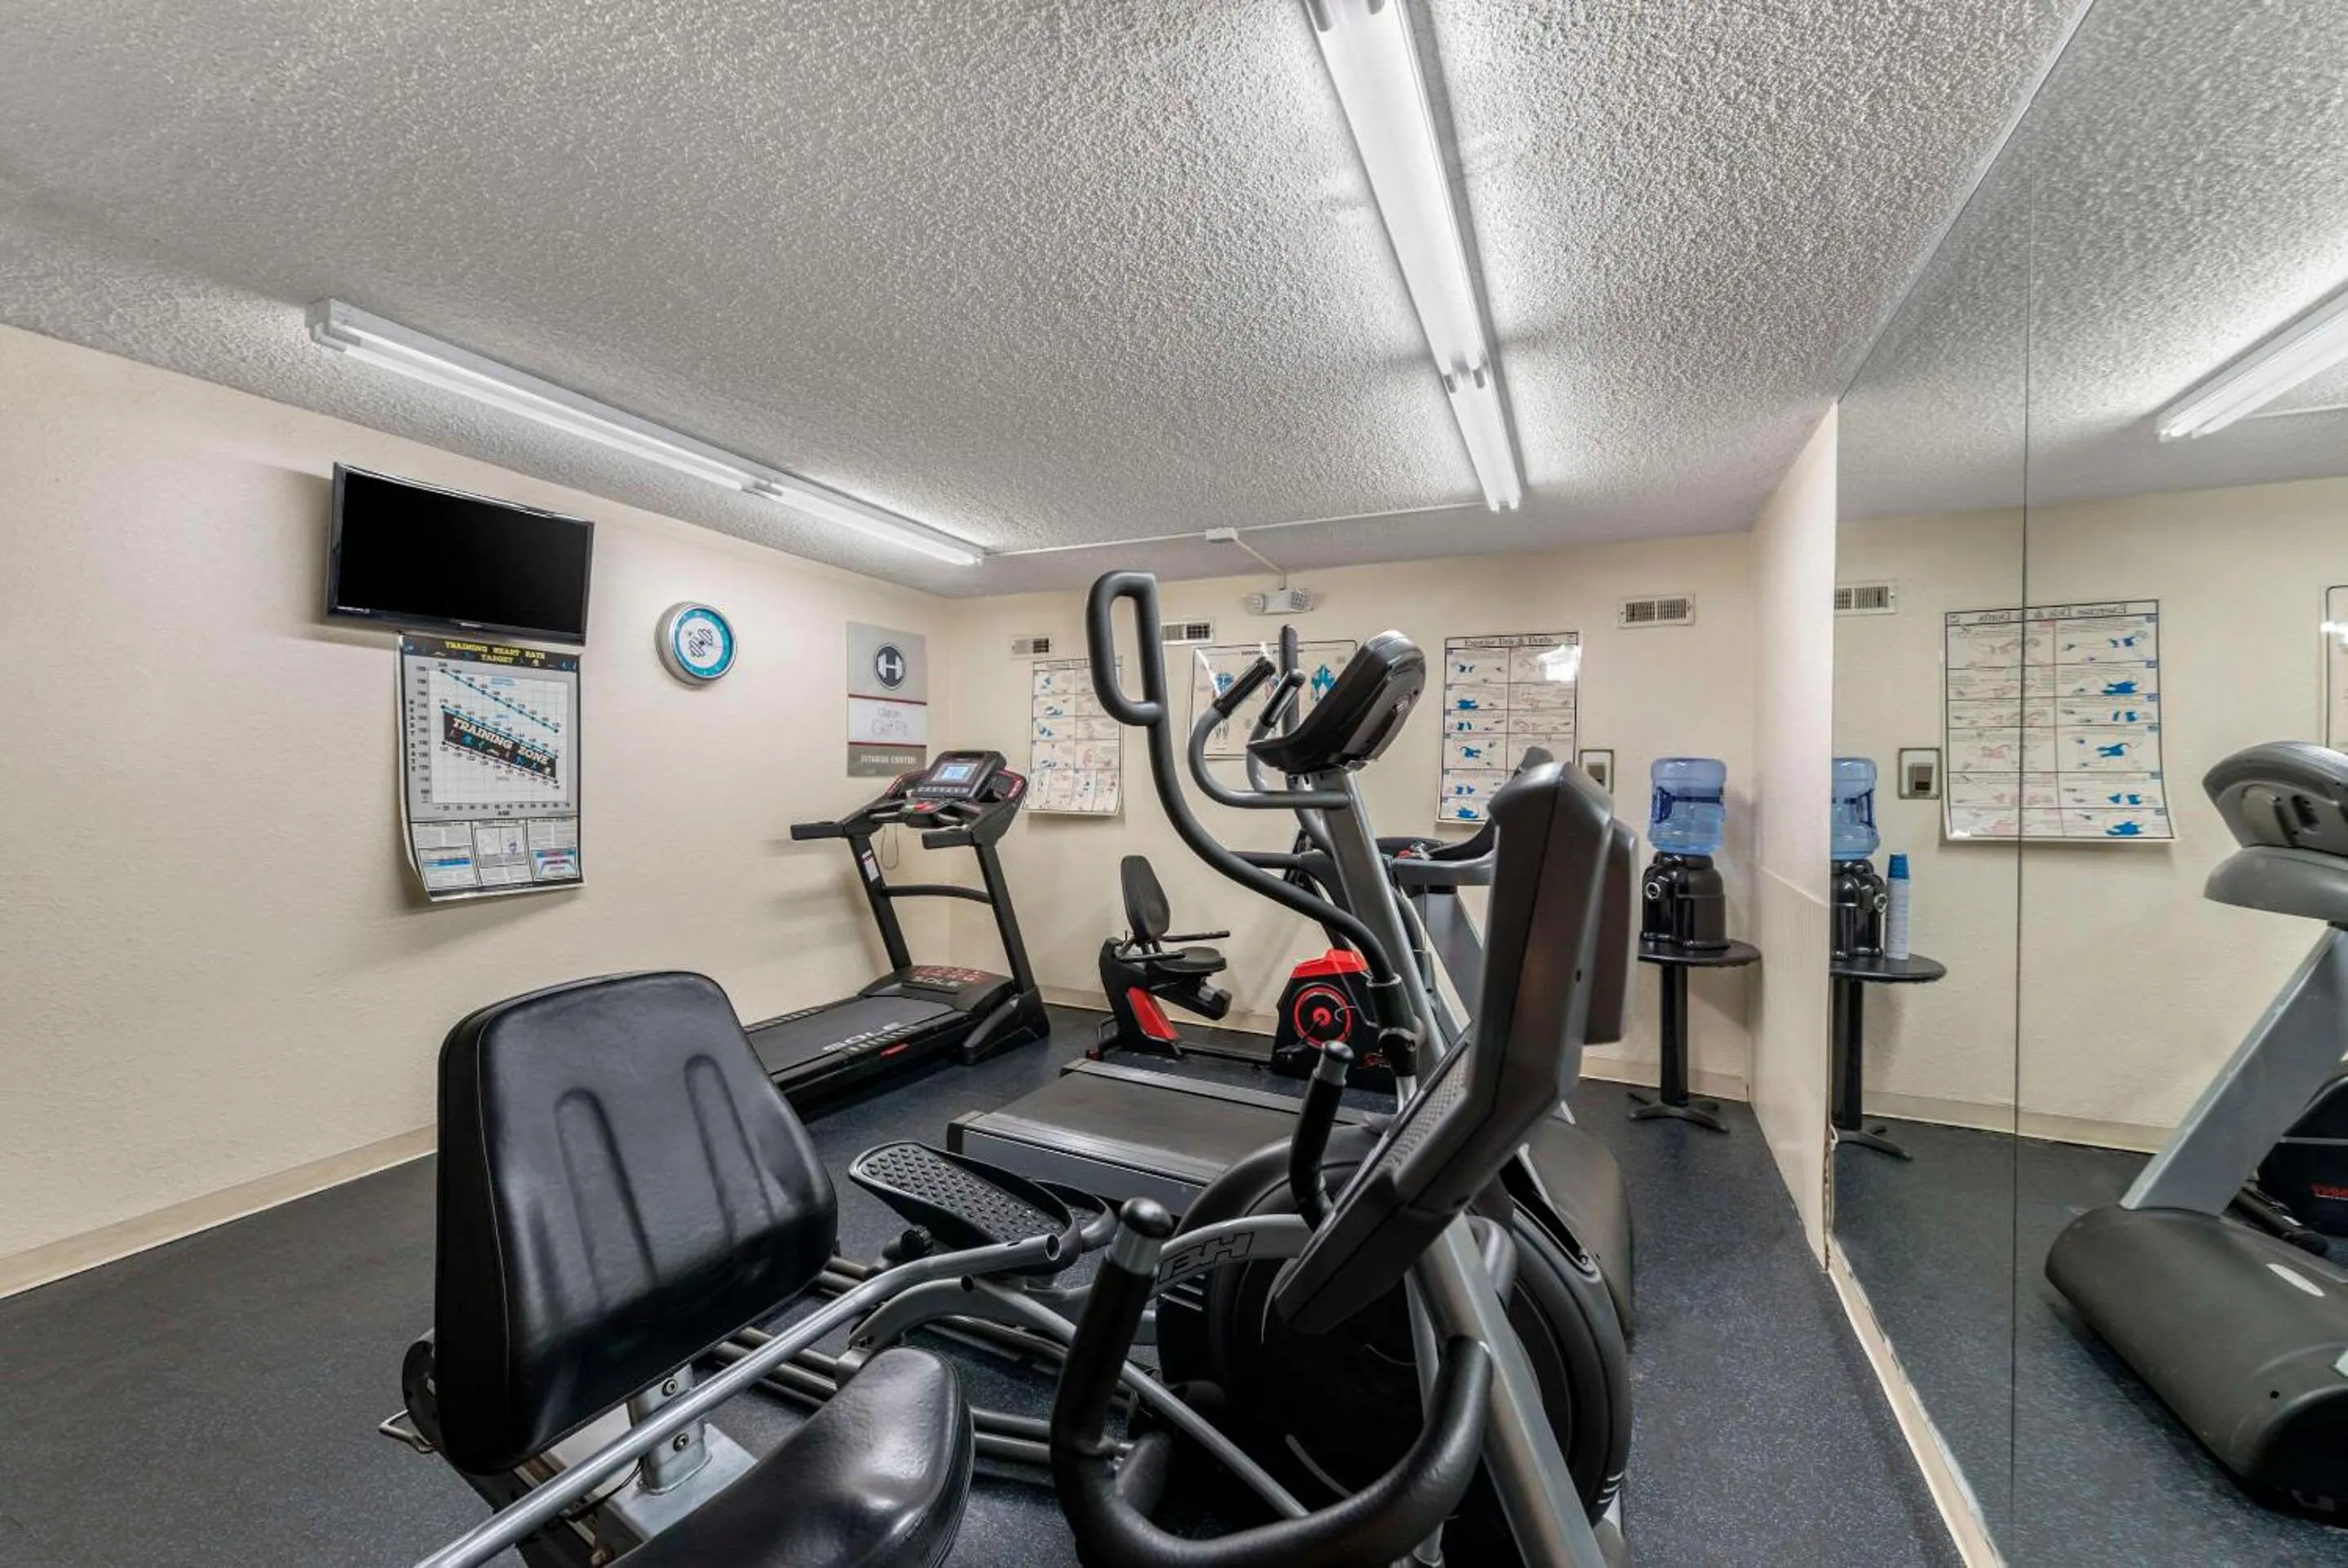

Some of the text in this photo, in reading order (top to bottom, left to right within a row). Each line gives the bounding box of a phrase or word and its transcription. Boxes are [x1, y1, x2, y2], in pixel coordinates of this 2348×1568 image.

[444, 641, 546, 660] TRAINING HEART RATE
[480, 654, 514, 664] TARGET
[453, 718, 550, 765] TRAINING ZONE
[822, 1022, 900, 1053] SOLE
